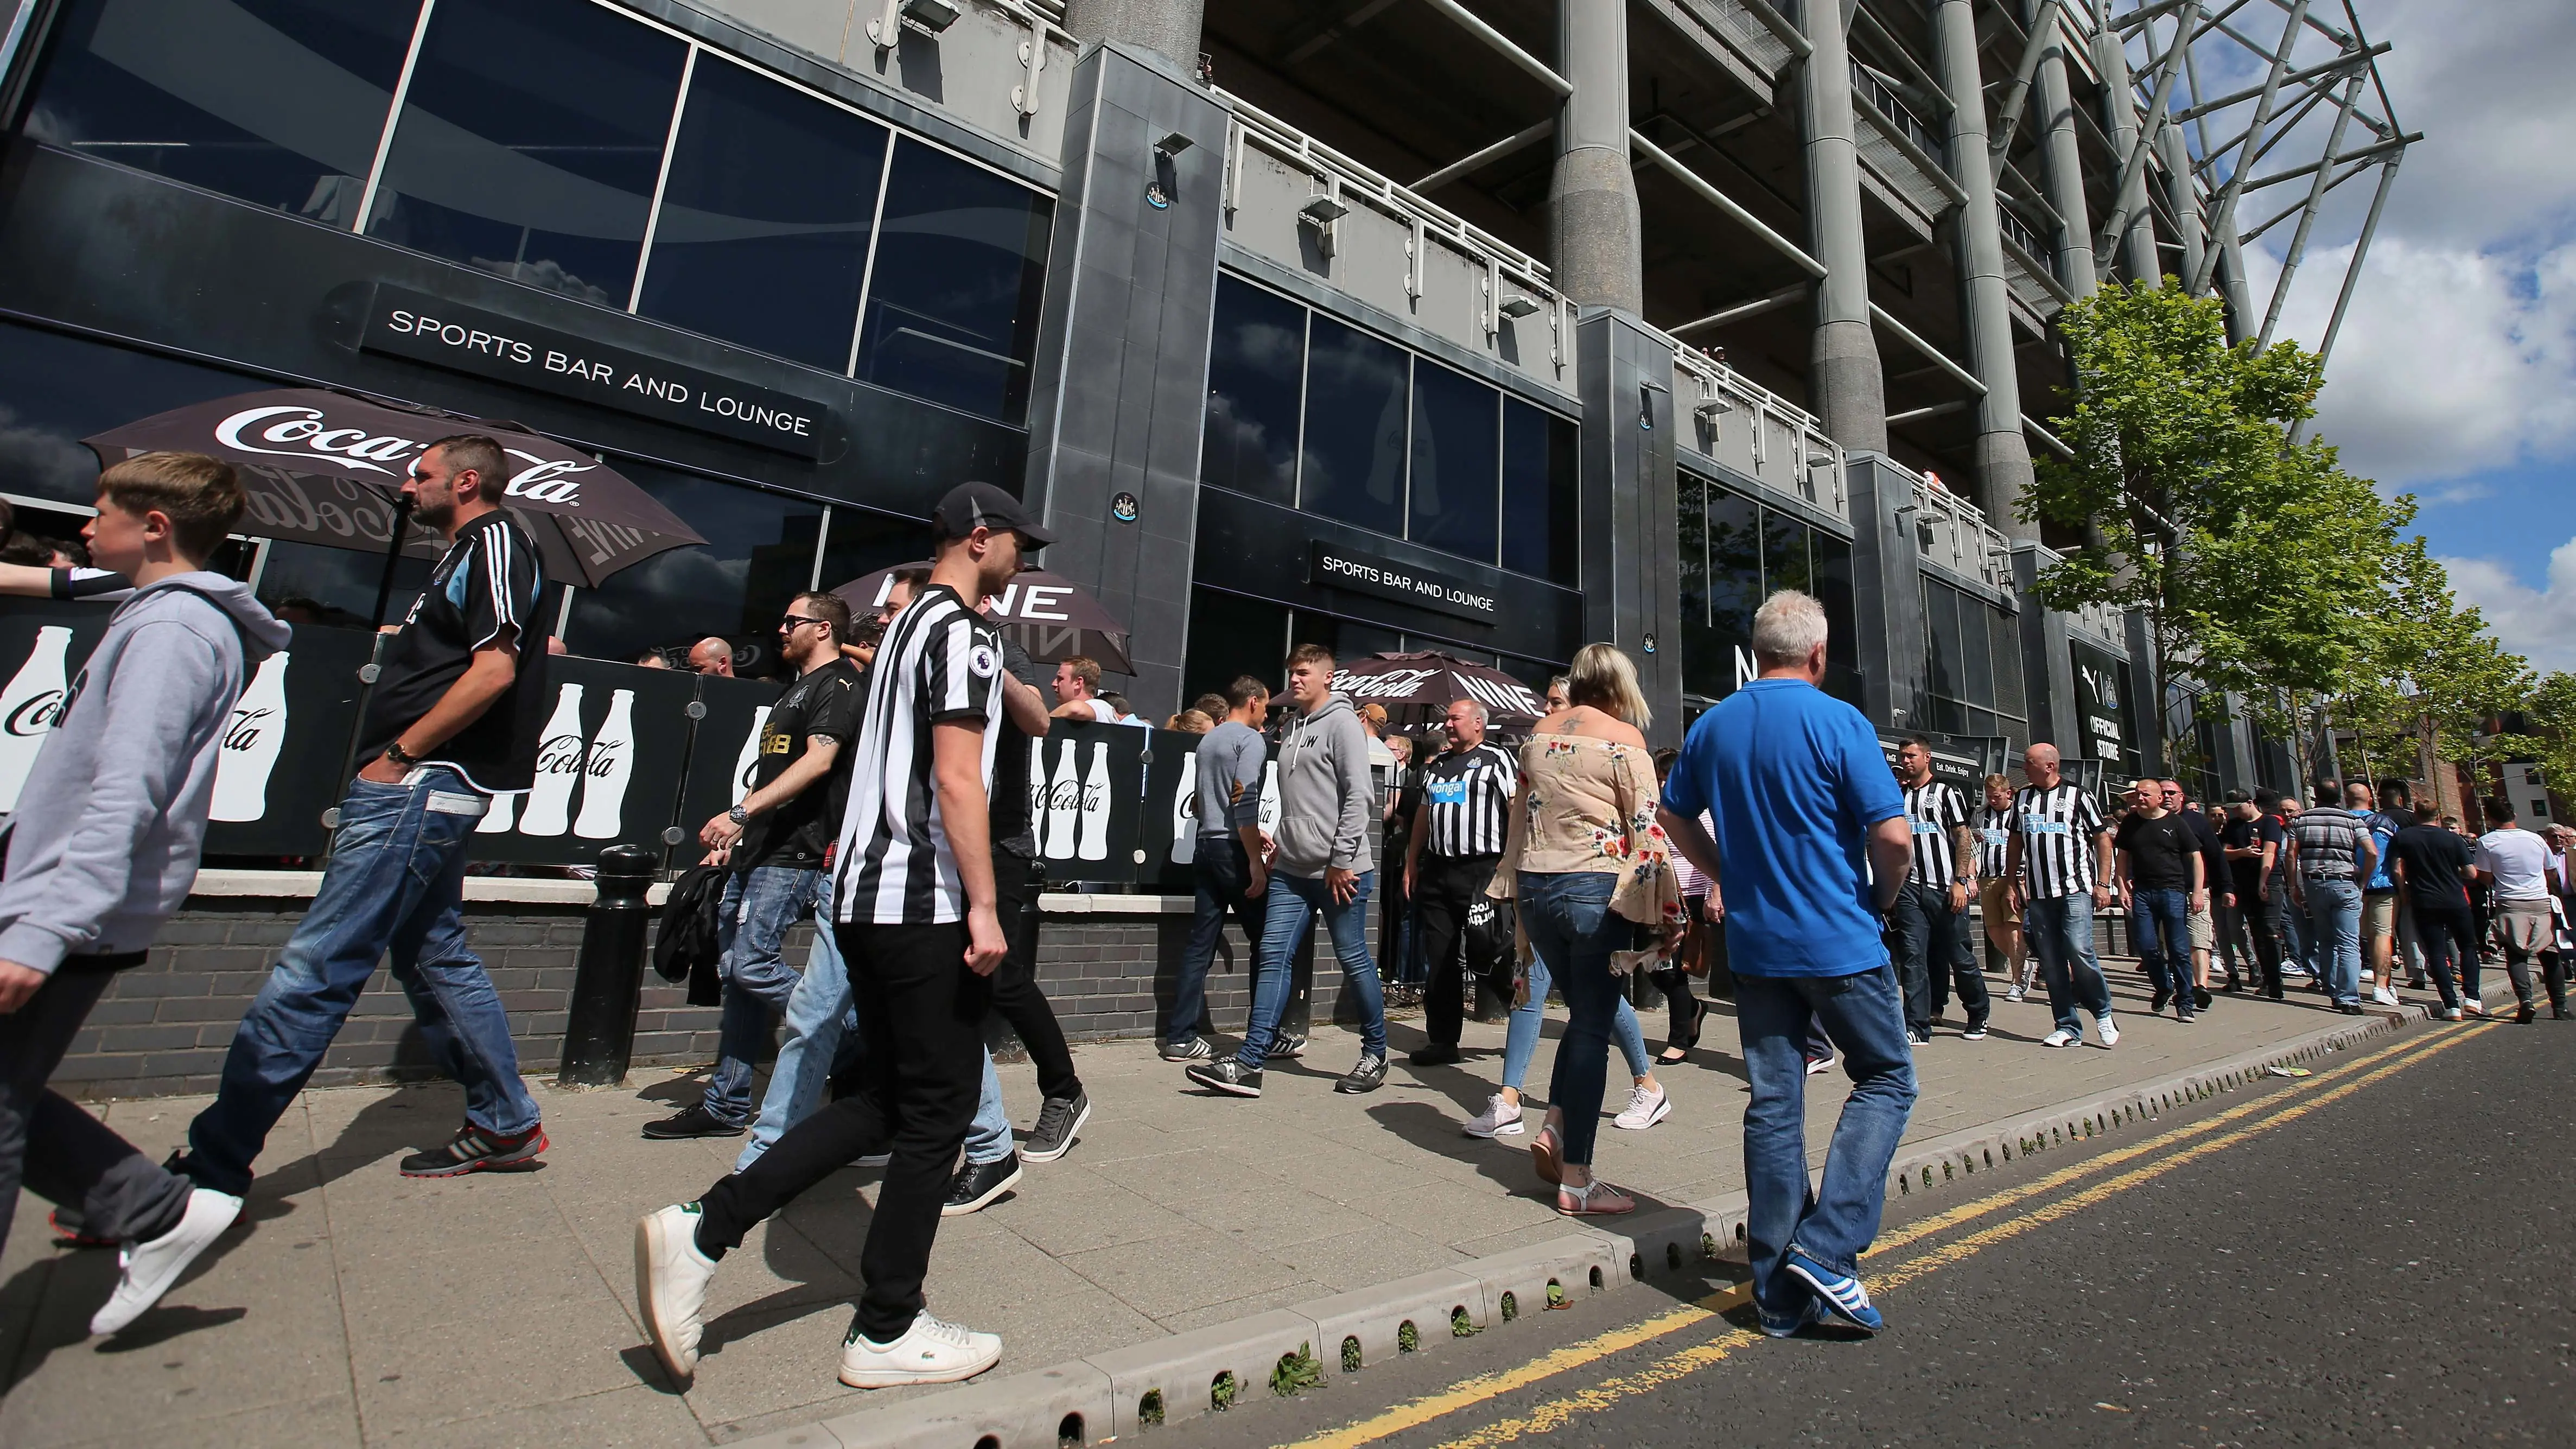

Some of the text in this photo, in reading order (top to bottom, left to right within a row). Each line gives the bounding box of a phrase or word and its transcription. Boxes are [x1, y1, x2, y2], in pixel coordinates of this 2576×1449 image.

[388, 310, 811, 437] SPORTS BAR AND LOUNGE
[1322, 556, 1494, 612] SPORTS BAR AND LOUNGE
[1451, 670, 1545, 718] NINE
[2090, 715, 2121, 740] OFFICIAL
[2097, 739, 2120, 761] STORE
